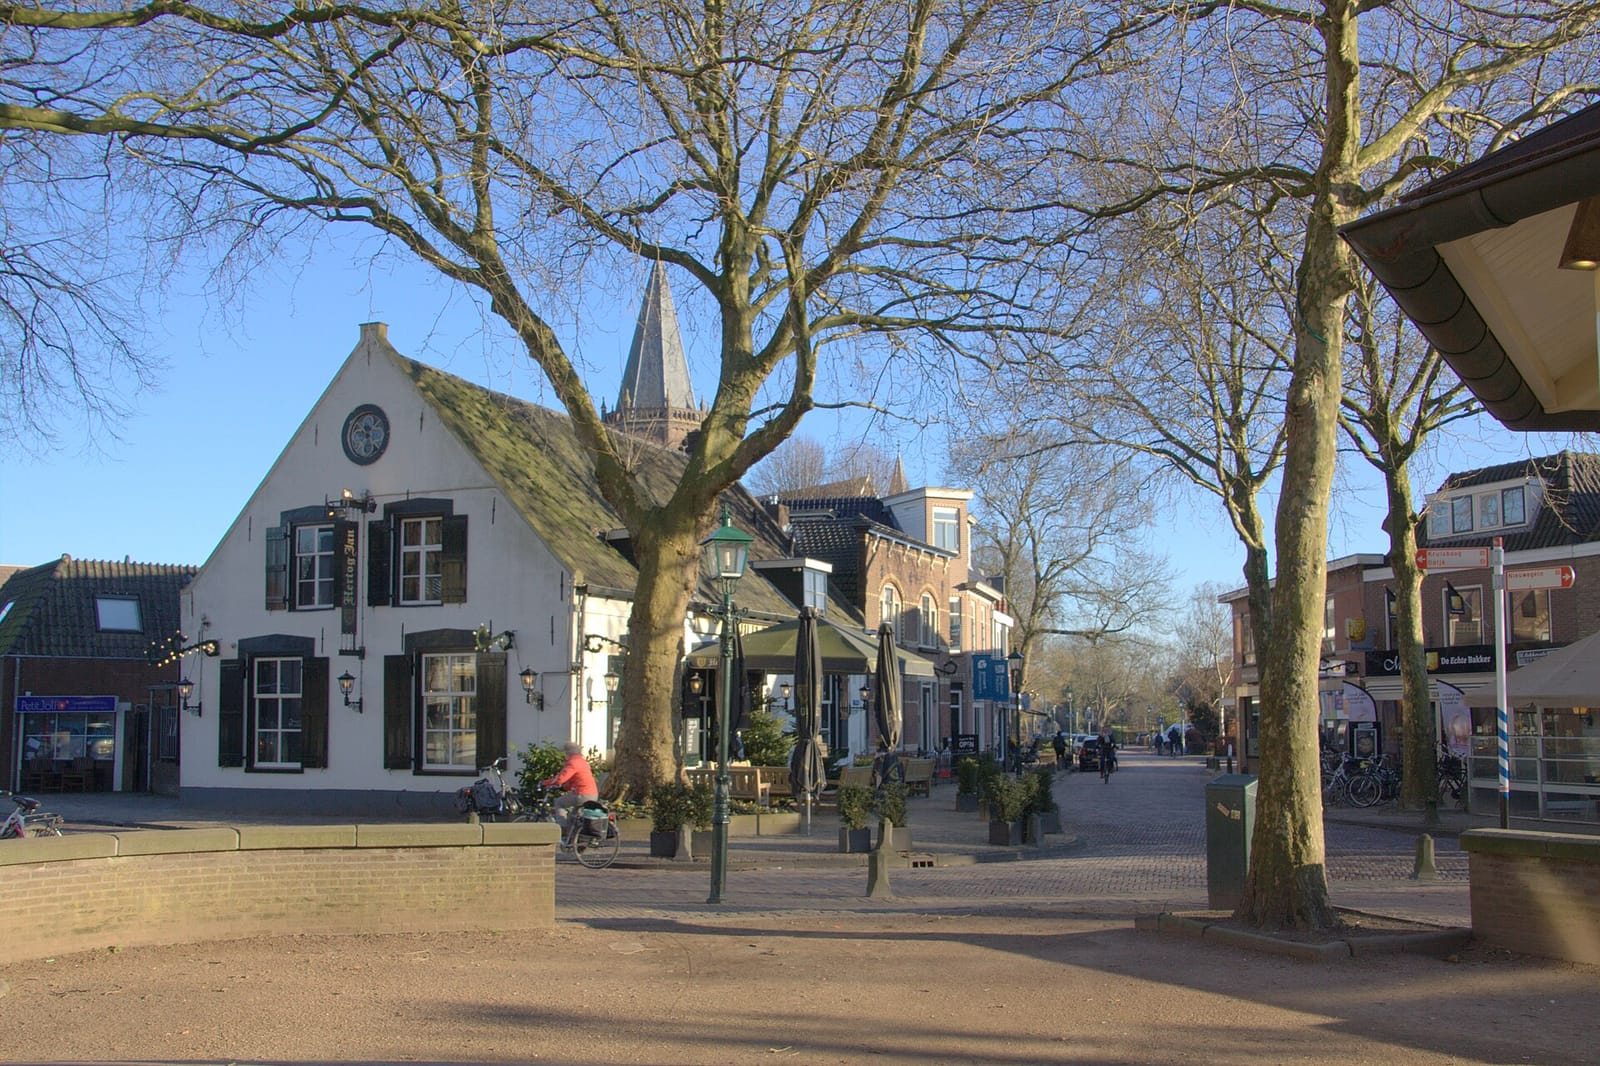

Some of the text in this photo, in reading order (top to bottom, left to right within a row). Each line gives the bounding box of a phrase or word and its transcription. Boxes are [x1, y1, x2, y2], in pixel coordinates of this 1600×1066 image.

[343, 529, 356, 606] Hertog Jan
[1440, 655, 1491, 665] De Echte Bakker
